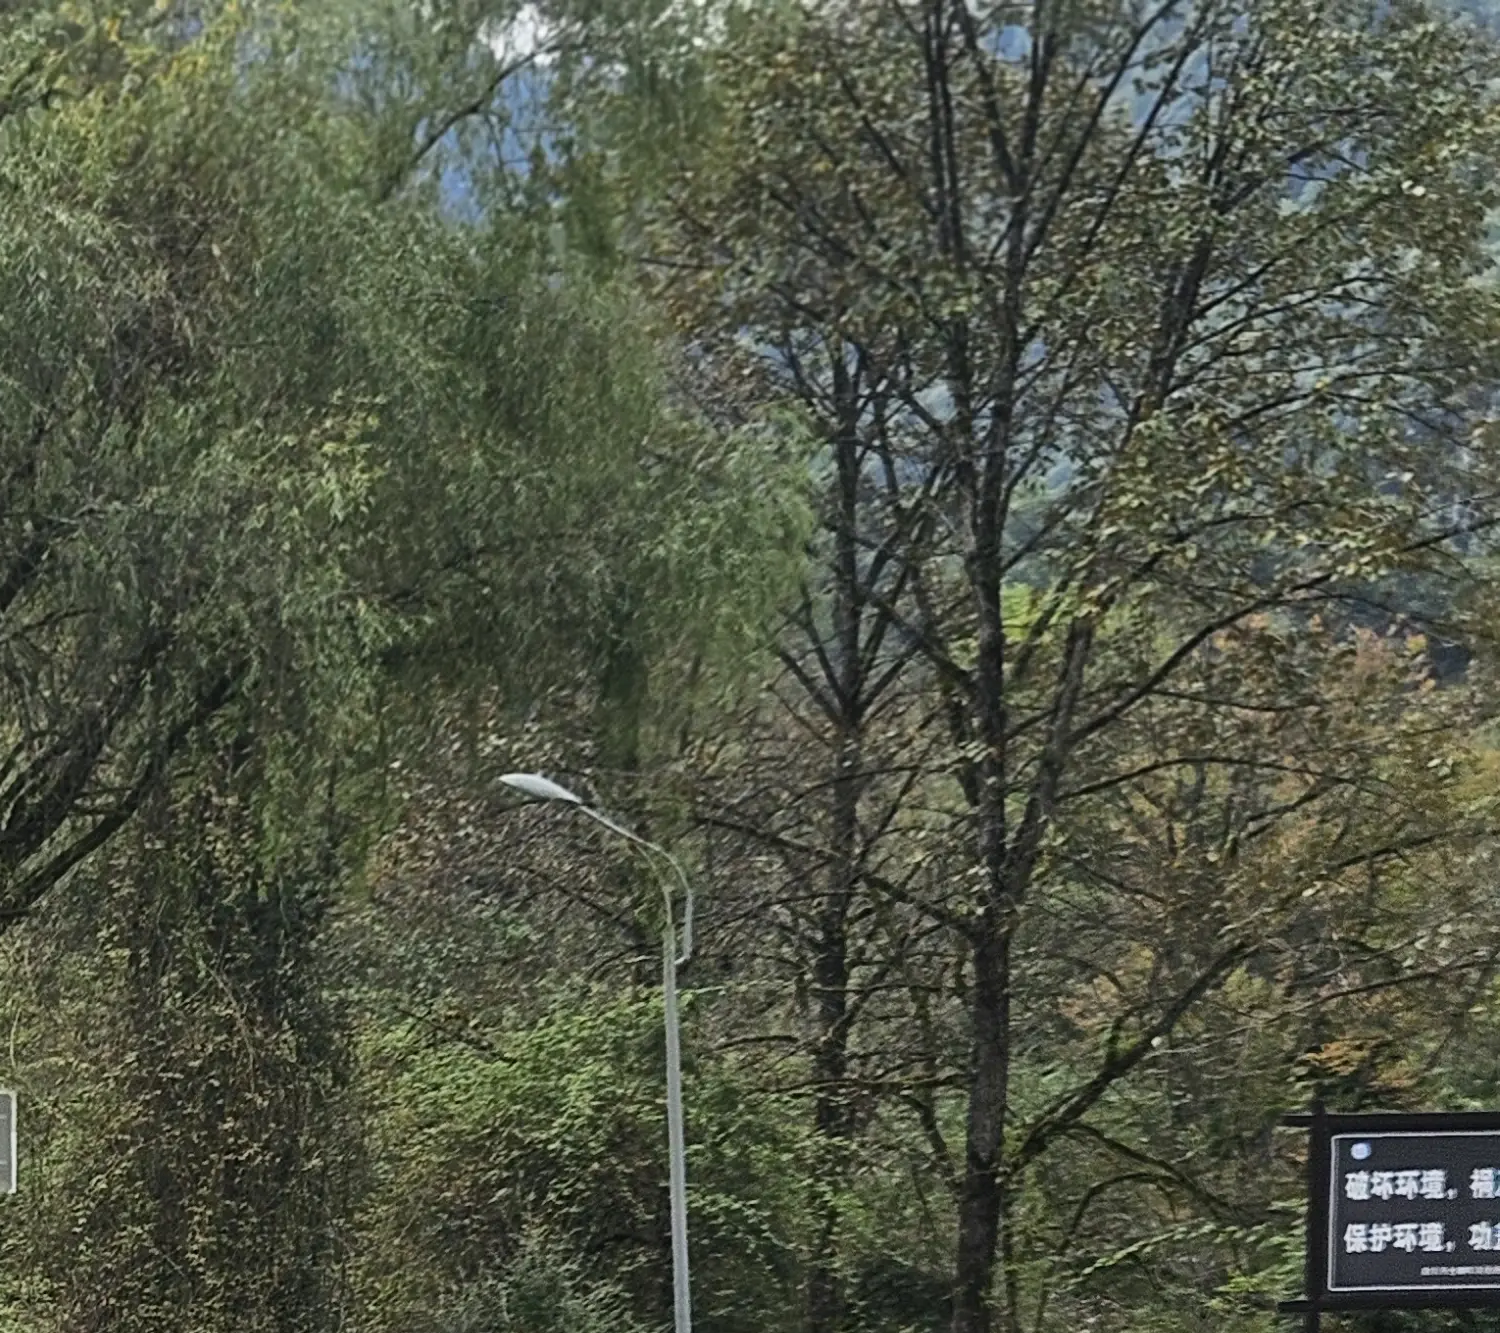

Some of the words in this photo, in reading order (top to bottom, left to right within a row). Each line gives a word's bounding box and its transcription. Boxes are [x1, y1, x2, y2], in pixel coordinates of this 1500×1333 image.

[1343, 1221, 1500, 1253] 保护环境，功
